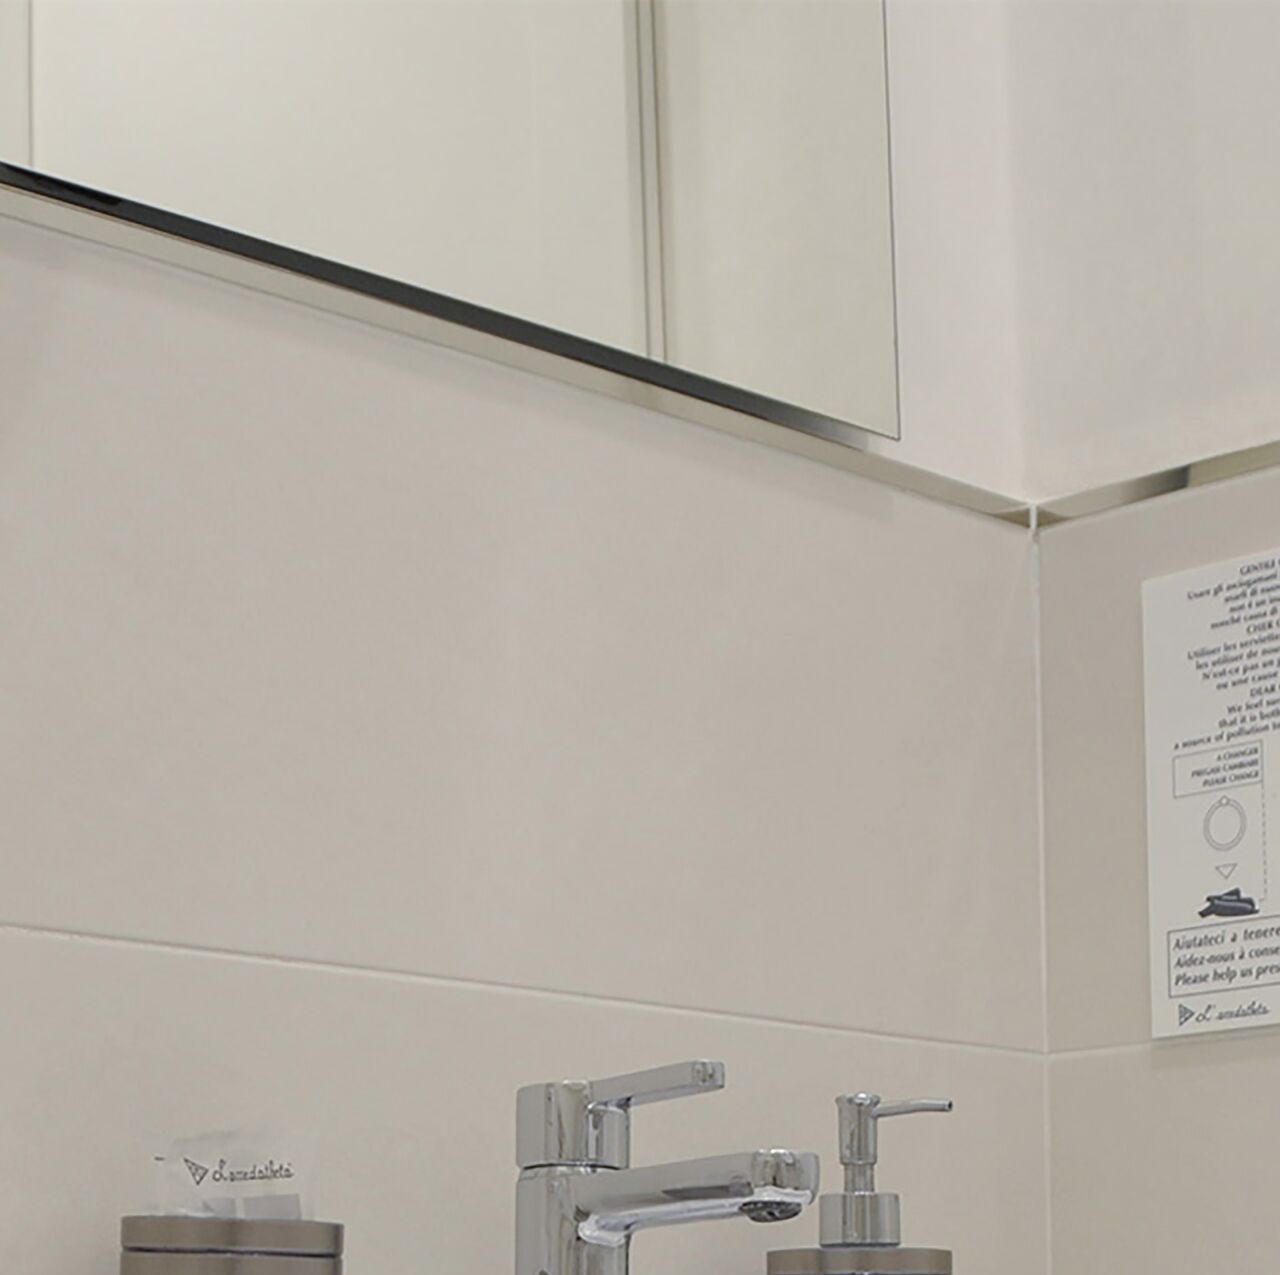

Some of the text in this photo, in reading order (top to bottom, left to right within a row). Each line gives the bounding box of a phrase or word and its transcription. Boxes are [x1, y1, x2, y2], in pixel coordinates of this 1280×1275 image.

[1250, 684, 1275, 697] DEAR
[1173, 930, 1225, 950] Aiutateci
[1231, 933, 1237, 943] a
[1175, 973, 1209, 986] Please
[1212, 966, 1237, 984] help
[1240, 968, 1253, 978] us
